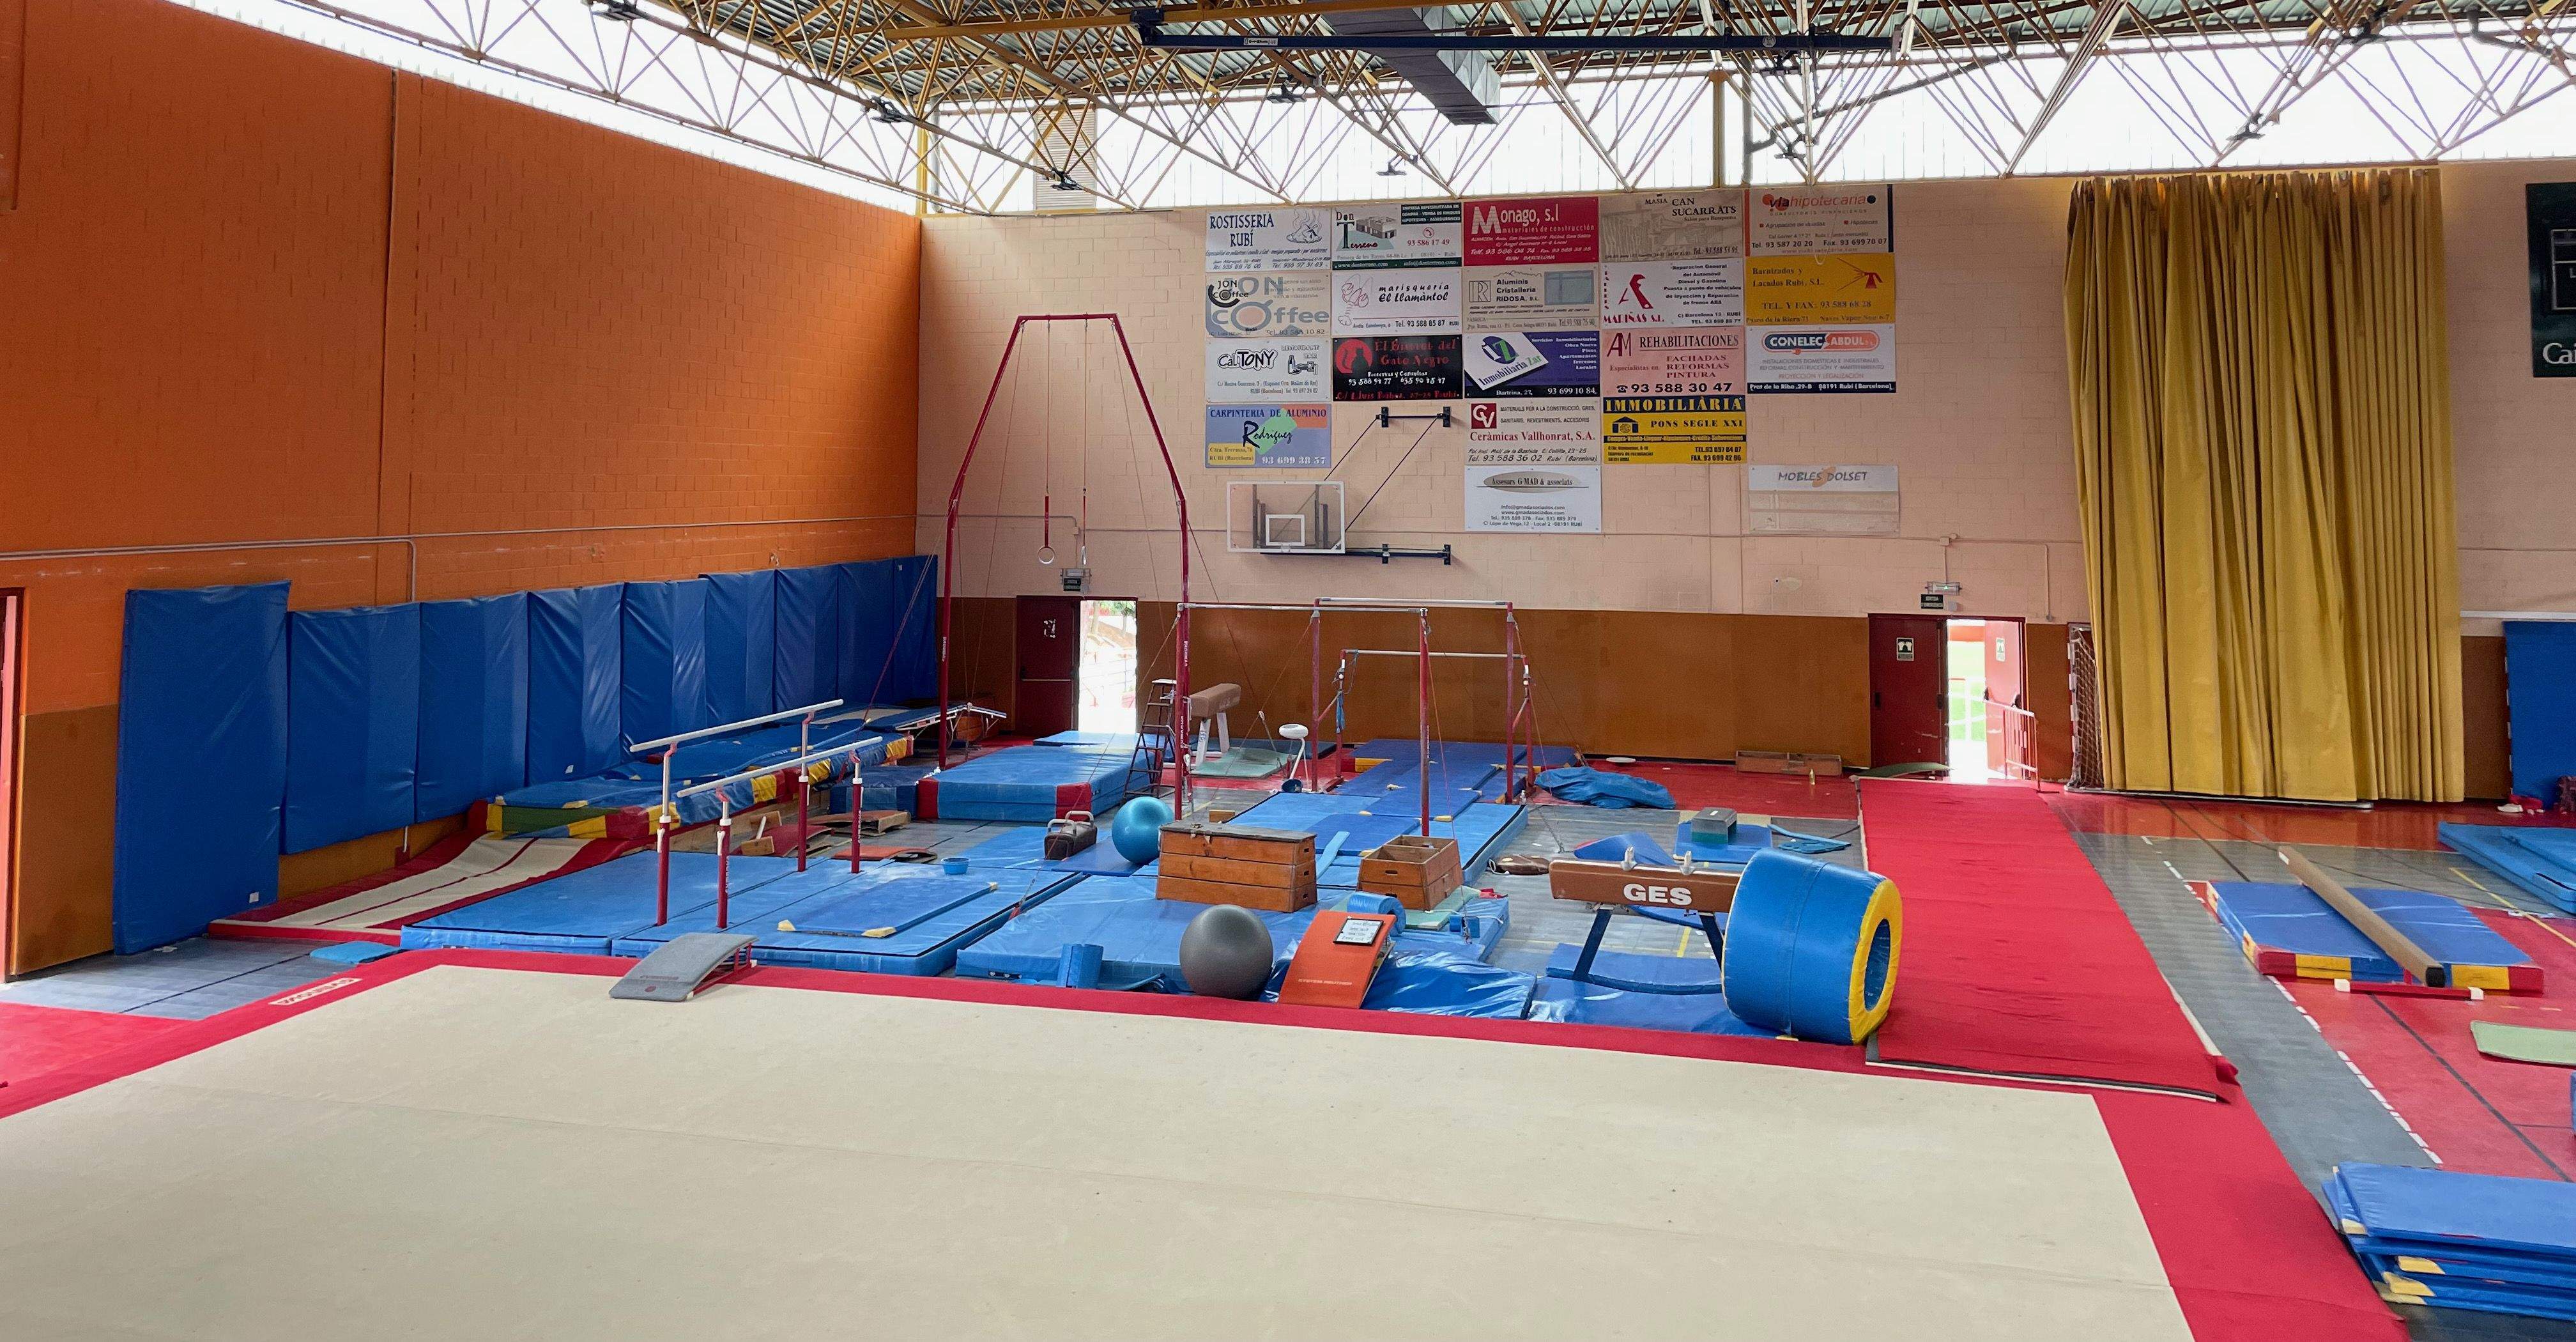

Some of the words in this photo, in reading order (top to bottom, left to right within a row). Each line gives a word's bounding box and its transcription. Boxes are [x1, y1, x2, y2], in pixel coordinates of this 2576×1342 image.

[1672, 198, 1695, 206] CAN
[1770, 195, 1867, 209] viahipotecaria
[1672, 206, 1736, 216] SUCARRATS
[1210, 213, 1274, 229] ROSTISSERIA
[1471, 205, 1540, 235] Monago,
[1230, 229, 1254, 247] RUBÍ
[1218, 280, 1238, 289] JON
[1379, 293, 1391, 302] El
[1607, 332, 1632, 357] AM
[1639, 334, 1739, 348] REHABILITACIONES
[1770, 336, 1823, 346] CONELEC
[1830, 336, 1864, 346] ABDUL
[1219, 355, 1238, 366] Cal
[1238, 350, 1275, 367] TONY
[1478, 361, 1528, 386] Inmobiliaria
[1631, 383, 1650, 393] 93
[1655, 383, 1683, 393] 588
[1689, 383, 1707, 392] 30
[1713, 383, 1732, 392] 47
[1606, 396, 1742, 412] IMMOBILIÀRIA
[1210, 409, 1264, 417] CARPINTERIA
[1287, 409, 1326, 417] ALUMINIO
[1521, 431, 1574, 442] Vallhonrat,
[1576, 431, 1595, 440] S.A.
[1778, 472, 1821, 481] MOBLES
[1827, 472, 1867, 481] DOLSET
[1623, 883, 1692, 906] GES
